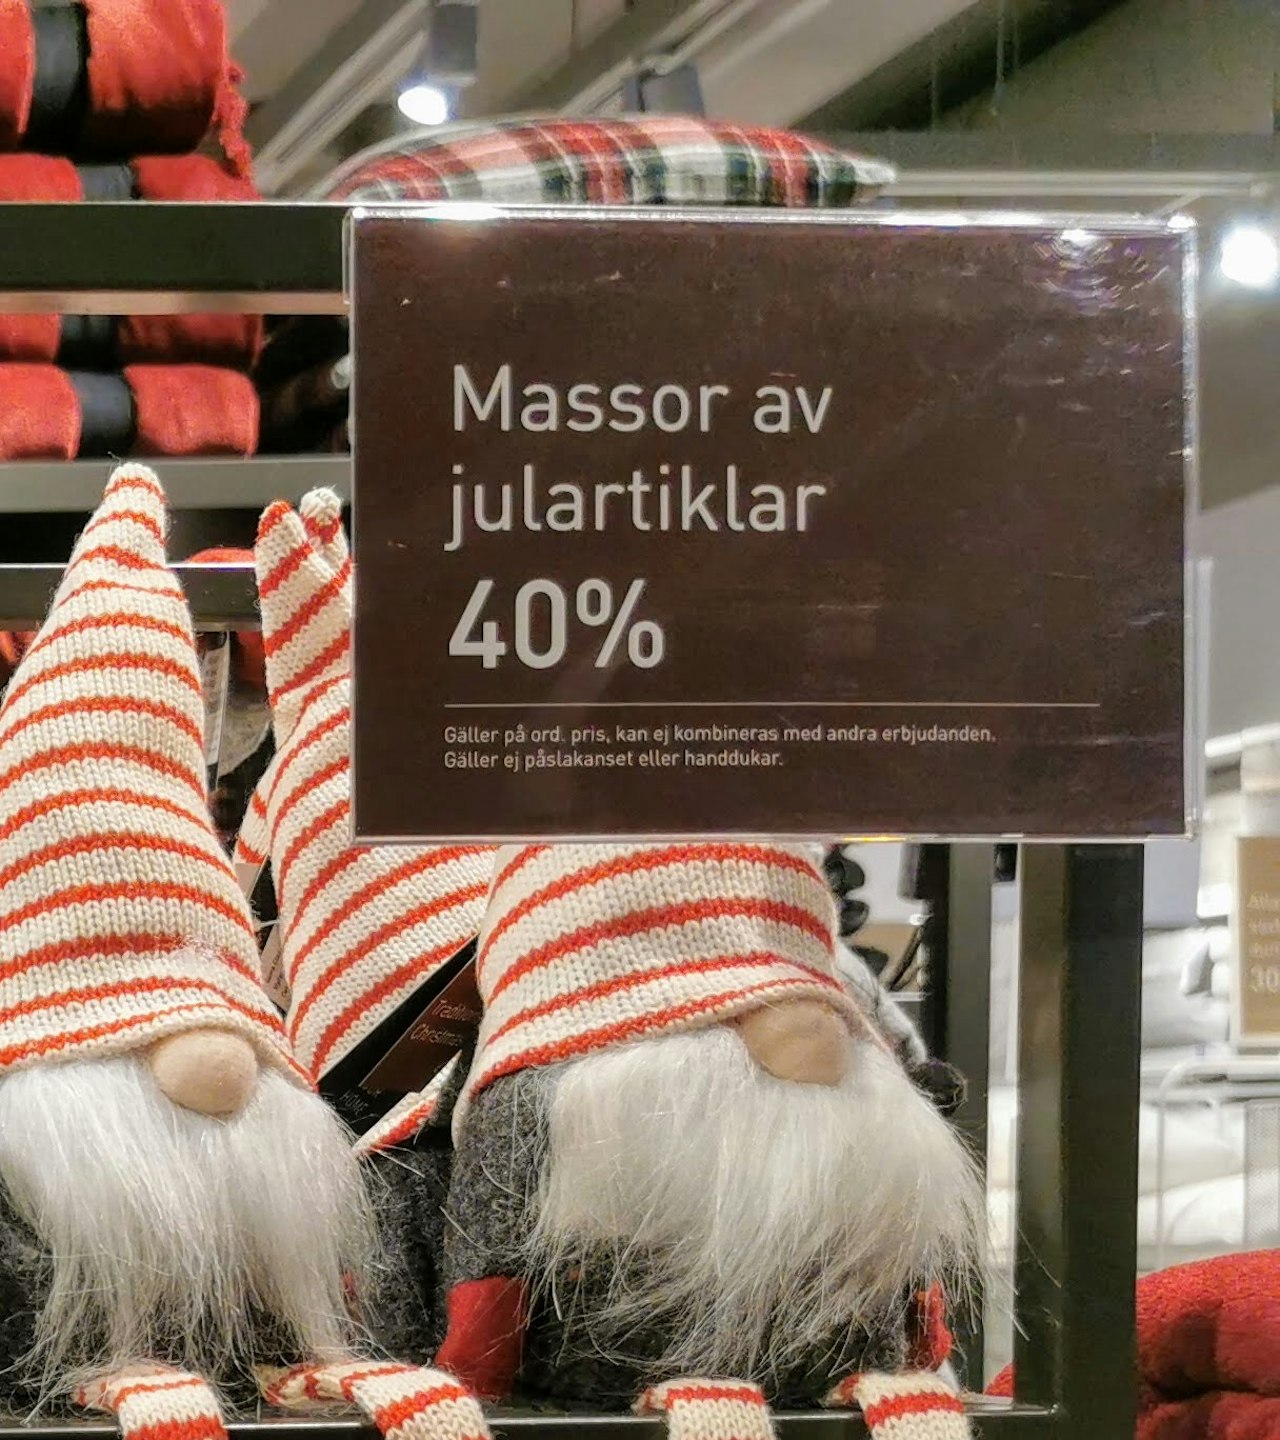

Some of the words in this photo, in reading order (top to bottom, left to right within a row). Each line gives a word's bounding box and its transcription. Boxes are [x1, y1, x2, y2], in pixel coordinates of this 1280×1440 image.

[453, 364, 730, 433] Massor
[753, 384, 833, 433] av
[443, 464, 828, 551] julartiklar
[448, 578, 666, 669] 40%
[444, 726, 500, 743] Gäller
[504, 724, 526, 747] på
[530, 726, 566, 743] ord.
[571, 725, 611, 746] pris,
[615, 725, 647, 743] kan
[652, 725, 670, 745] ej
[674, 725, 778, 743] kombineras
[783, 724, 822, 742] med
[826, 724, 877, 742] andra
[882, 725, 997, 746] erbjudanden.
[444, 751, 500, 768] Gäller
[503, 752, 521, 771] ej
[524, 749, 634, 772] påslakanset
[638, 751, 680, 767] eller
[684, 750, 784, 767] handdukar.
